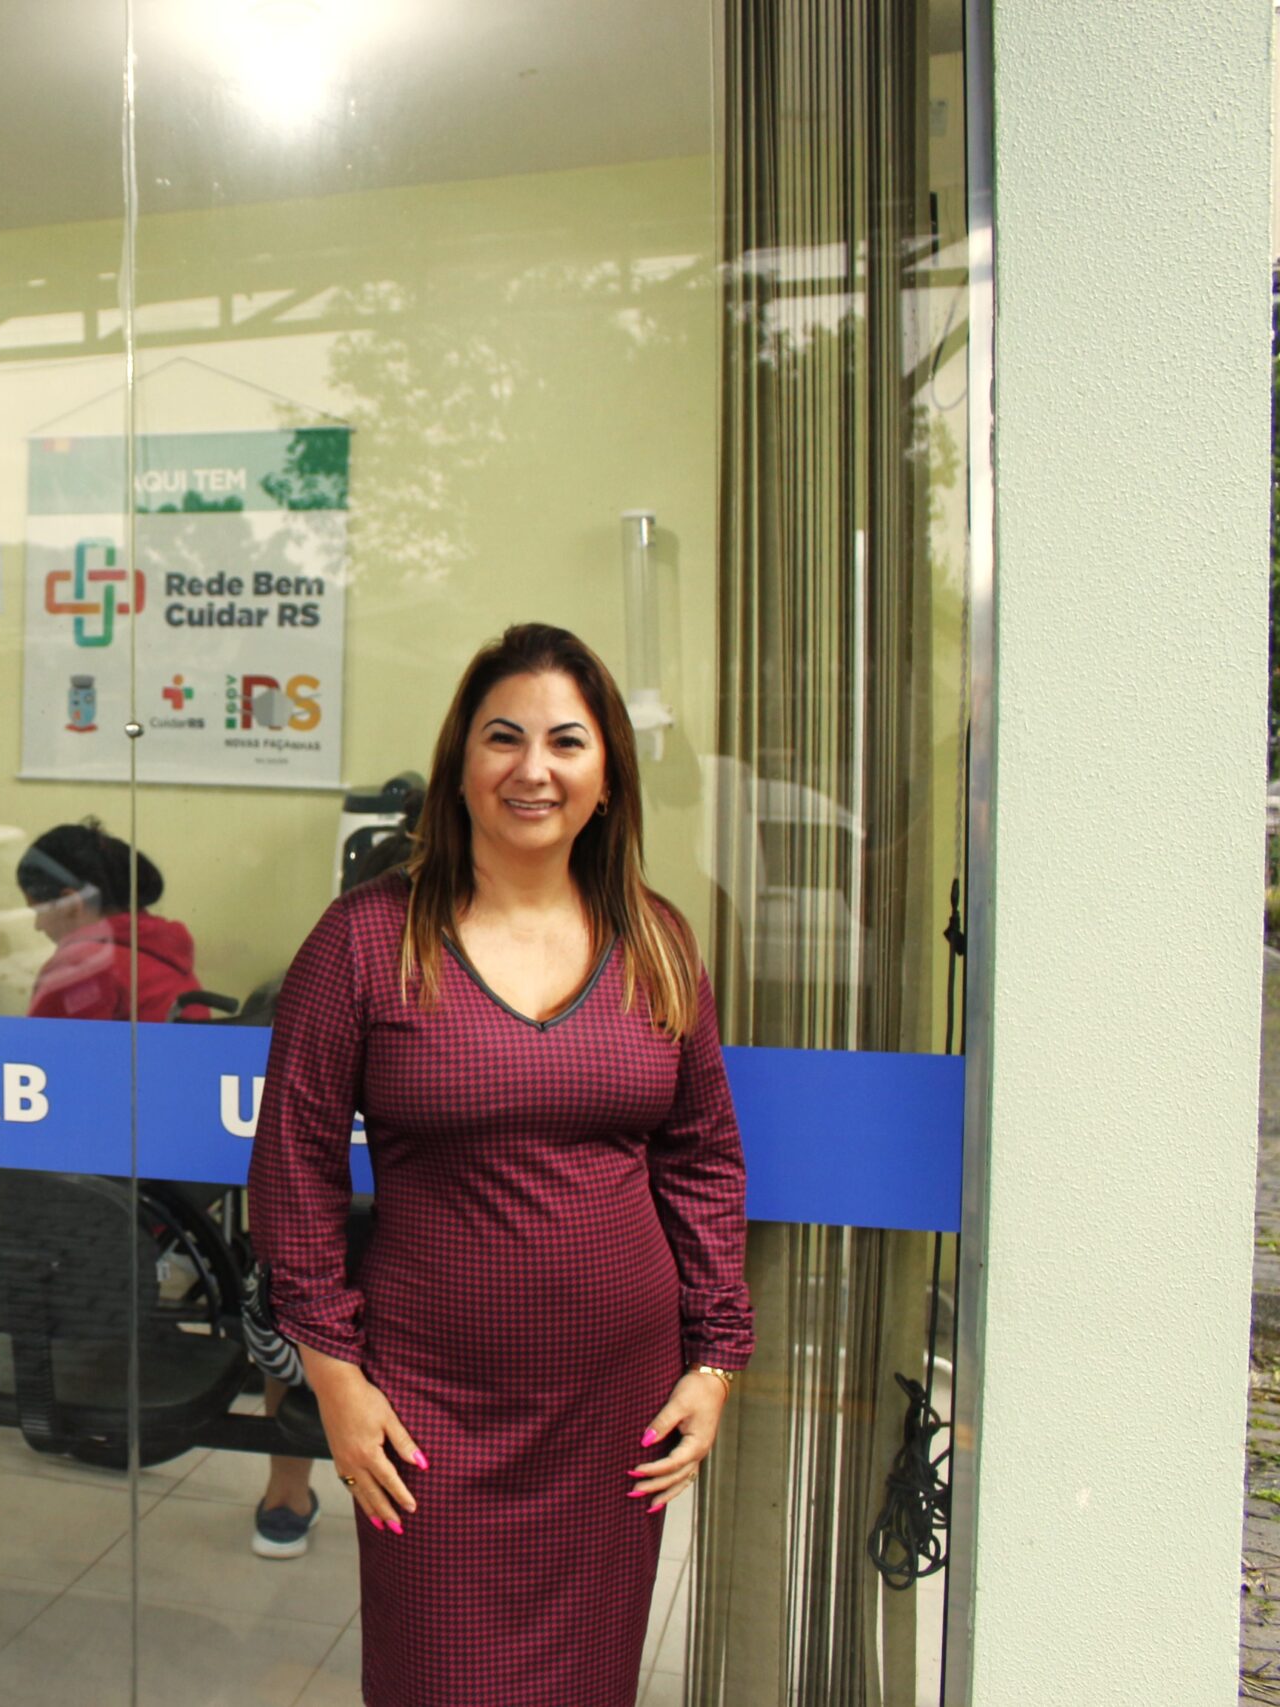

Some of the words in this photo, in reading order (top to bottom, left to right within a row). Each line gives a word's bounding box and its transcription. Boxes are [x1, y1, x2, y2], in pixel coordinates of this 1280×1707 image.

[193, 468, 247, 491] TEM
[165, 571, 244, 597] Rede
[252, 571, 325, 597] Bem
[165, 602, 269, 627] Cuidar
[277, 602, 321, 627] RS
[240, 674, 322, 732] RS
